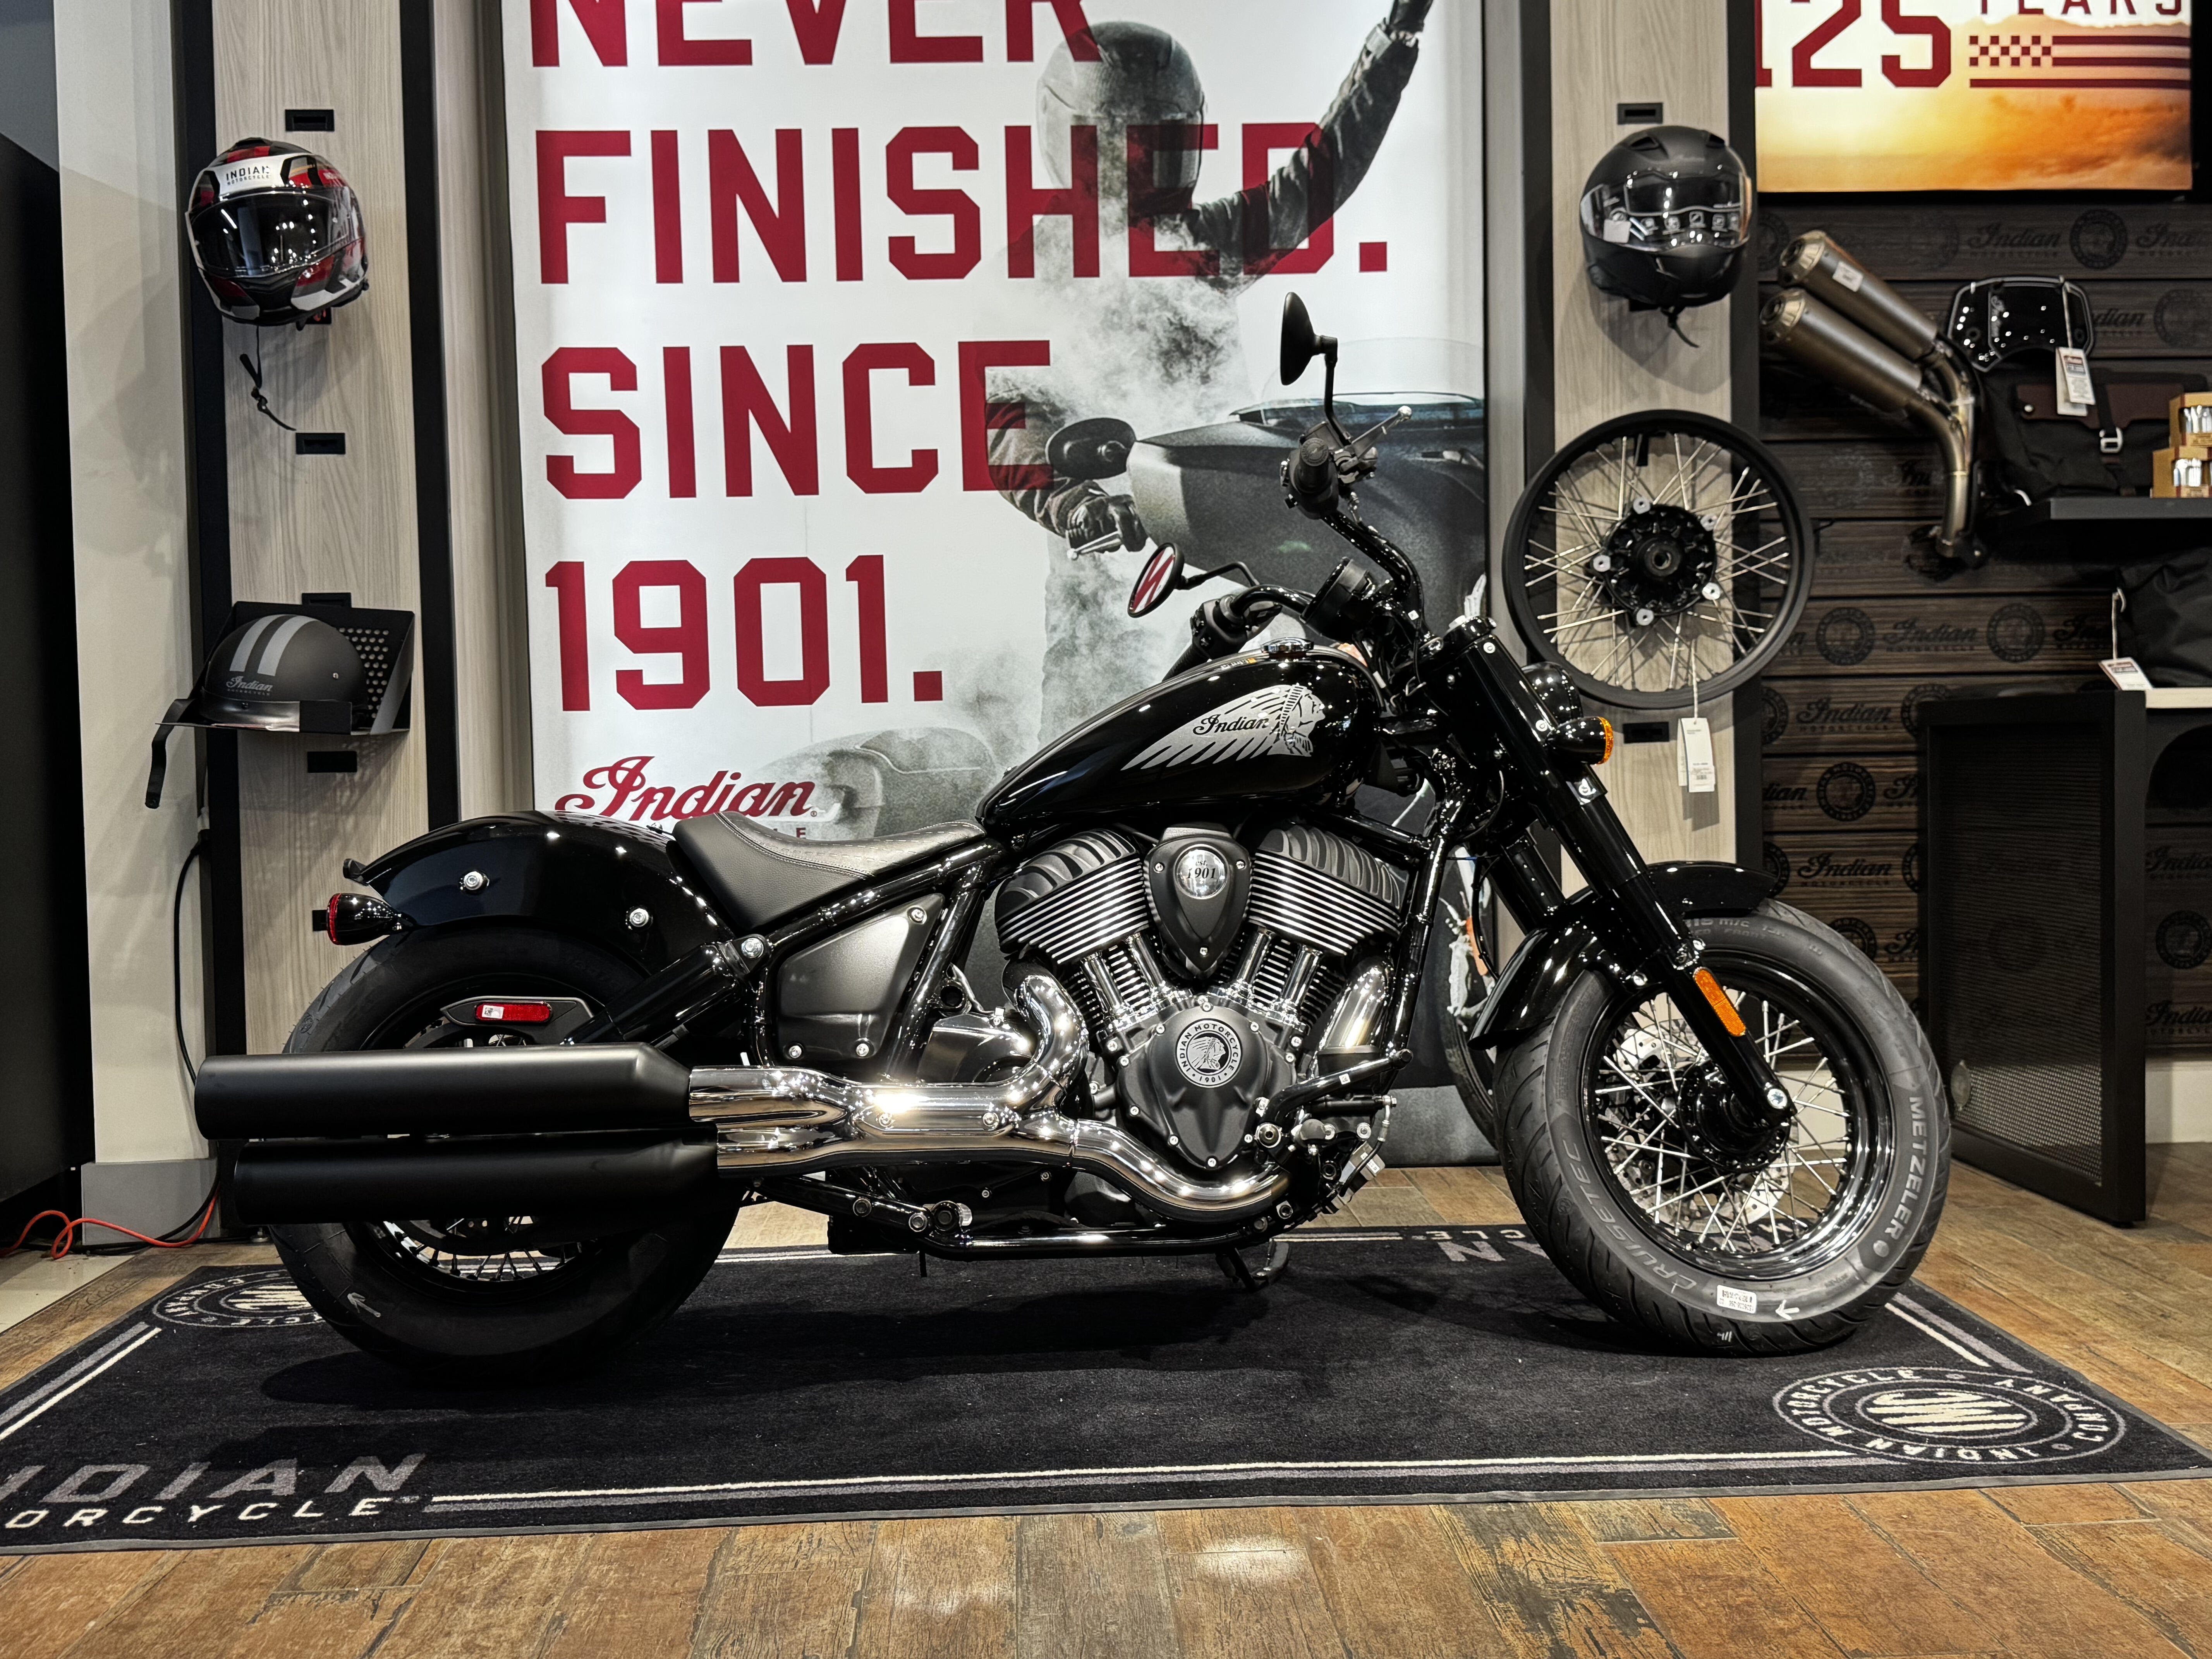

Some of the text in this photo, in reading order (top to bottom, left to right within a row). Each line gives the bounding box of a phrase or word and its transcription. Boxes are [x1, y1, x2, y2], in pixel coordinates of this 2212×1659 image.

[536, 122, 1387, 284] FINISHED.
[542, 340, 1054, 500] SINCE
[545, 555, 943, 712] 1901.
[226, 675, 273, 692] Indian
[1796, 697, 1891, 723] Indian
[1193, 714, 1269, 735] Indian
[555, 756, 815, 821] Indian
[1187, 867, 1216, 879] 1901
[1798, 853, 1891, 878] Indian
[1180, 1023, 1238, 1072] INDIAN MOTORCYCLE
[1884, 1097, 1927, 1240] METZELER
[1563, 1140, 1697, 1290] CRUISETEC
[1787, 1368, 2040, 1462] INDIAN MOTORCYCLE
[1994, 1378, 2111, 1443] COMPANY
